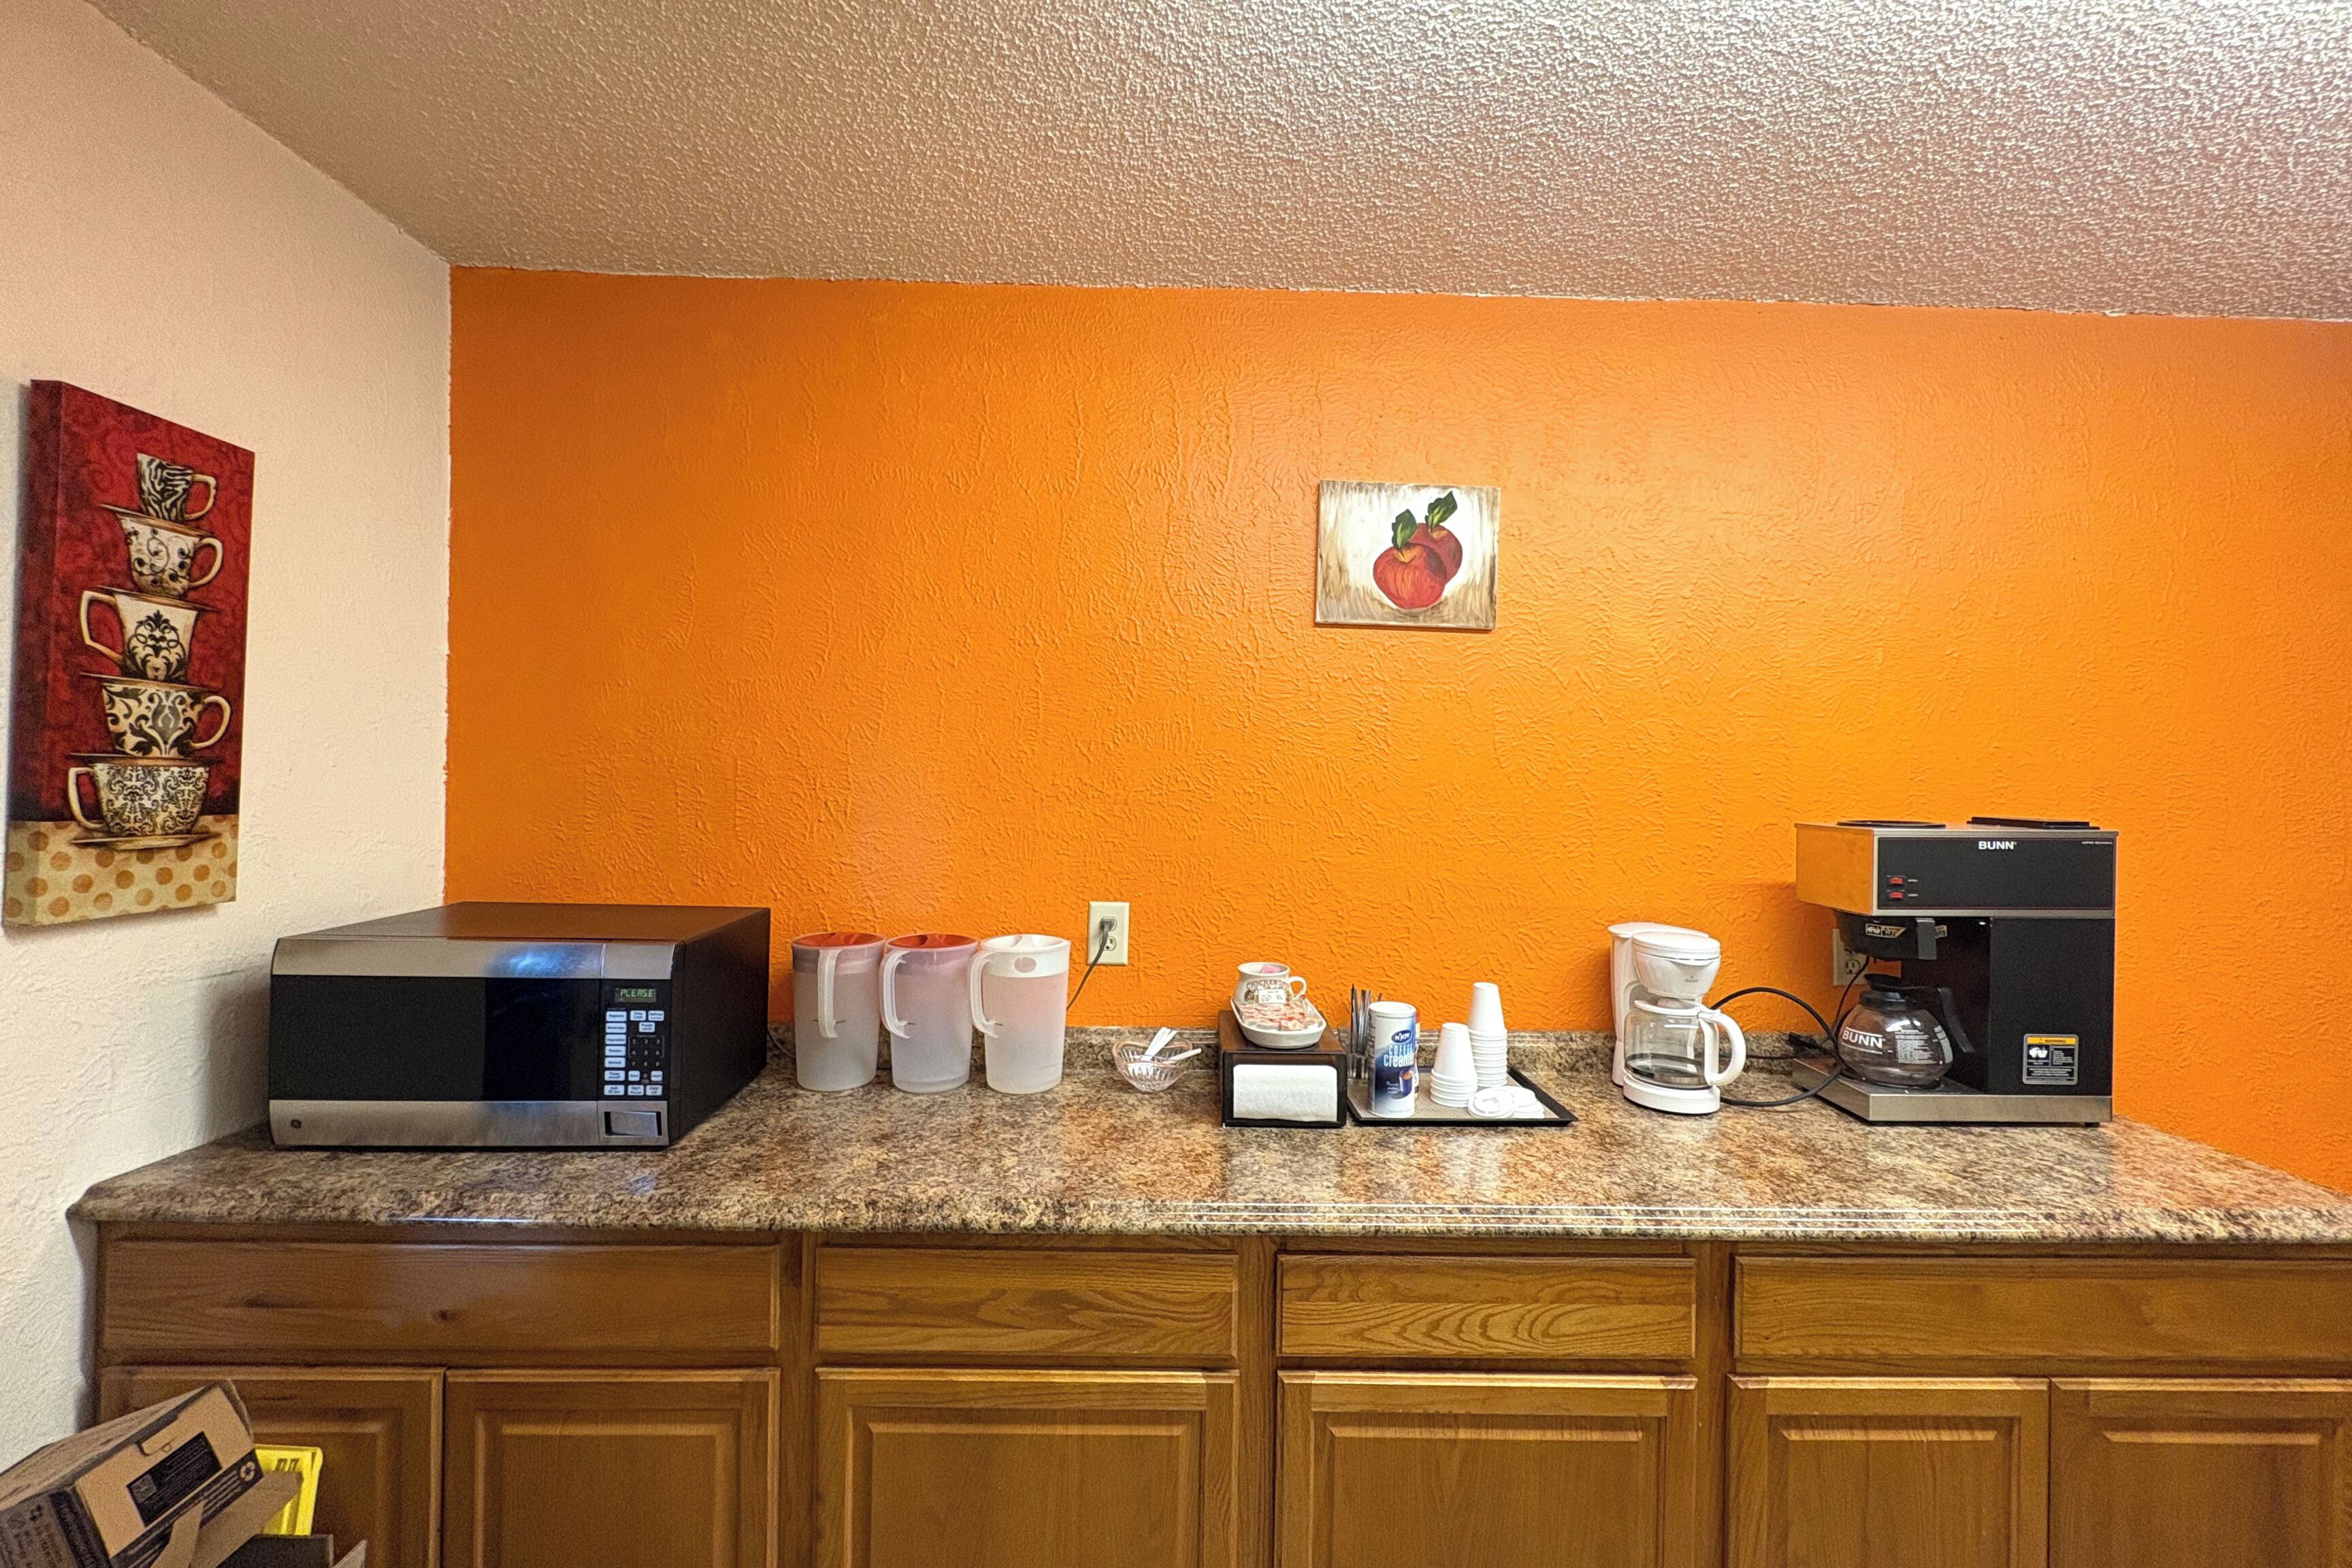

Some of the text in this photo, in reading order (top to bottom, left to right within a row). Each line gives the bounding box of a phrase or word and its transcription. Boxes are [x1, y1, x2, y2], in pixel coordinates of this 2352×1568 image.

[1978, 841, 2014, 850] BUNN
[620, 989, 653, 997] PLEASE
[1842, 1030, 1883, 1049] BUNN
